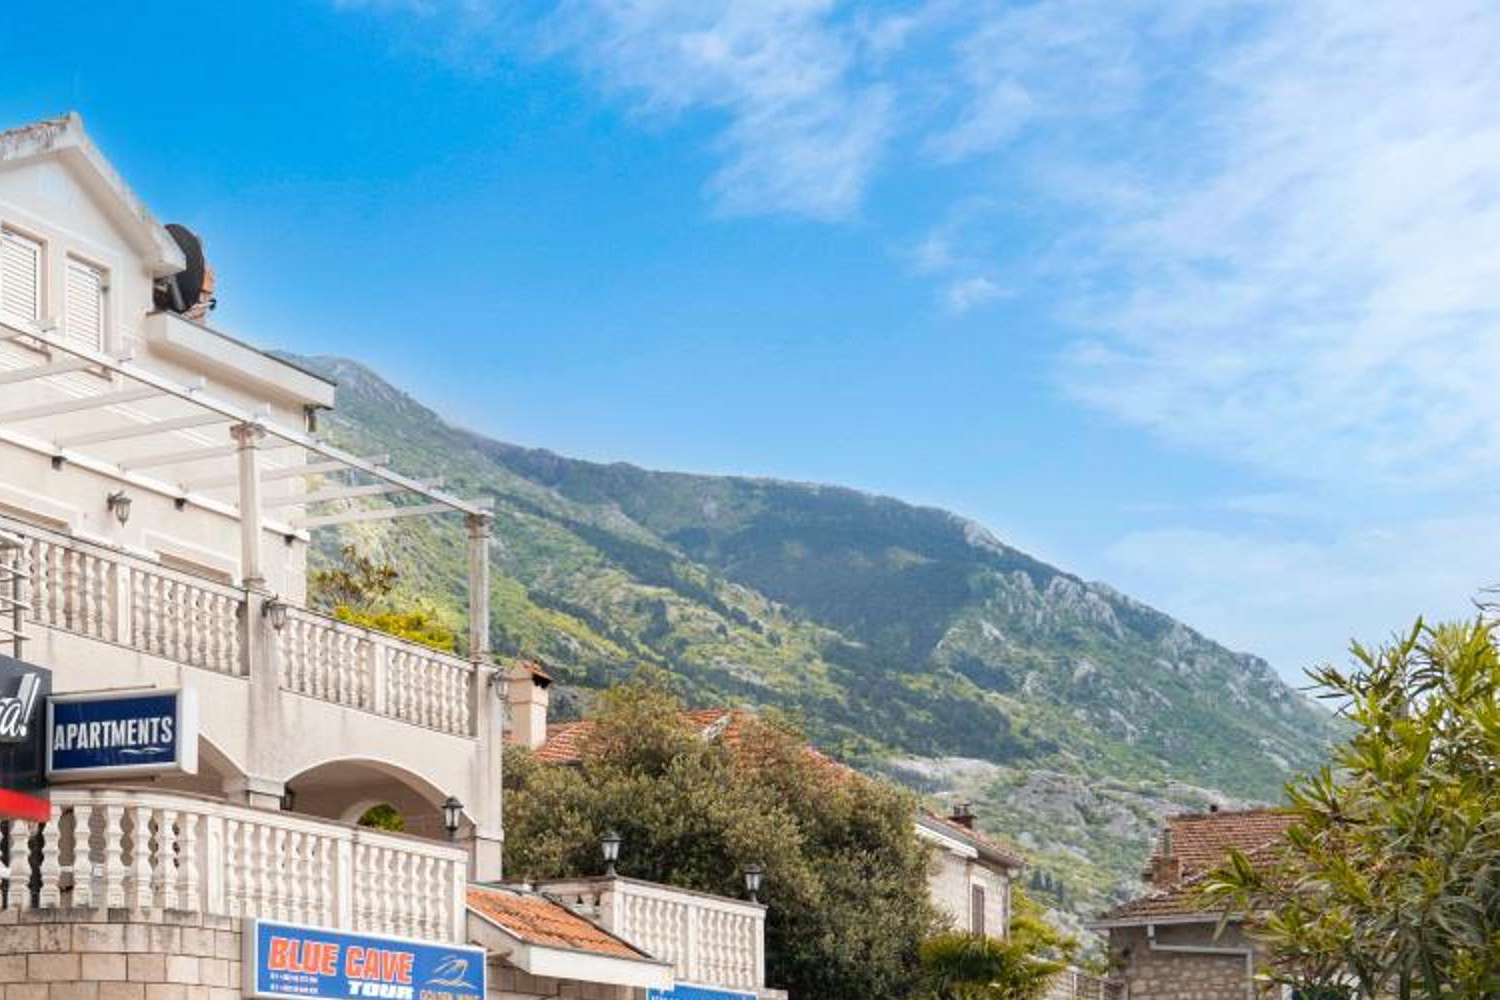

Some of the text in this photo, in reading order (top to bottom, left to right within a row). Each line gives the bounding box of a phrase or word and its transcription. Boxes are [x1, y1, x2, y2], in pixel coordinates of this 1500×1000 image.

[53, 716, 173, 751] APARTMENTS
[267, 935, 415, 984] BLUE CAVE
[347, 980, 415, 1000] TOUR
